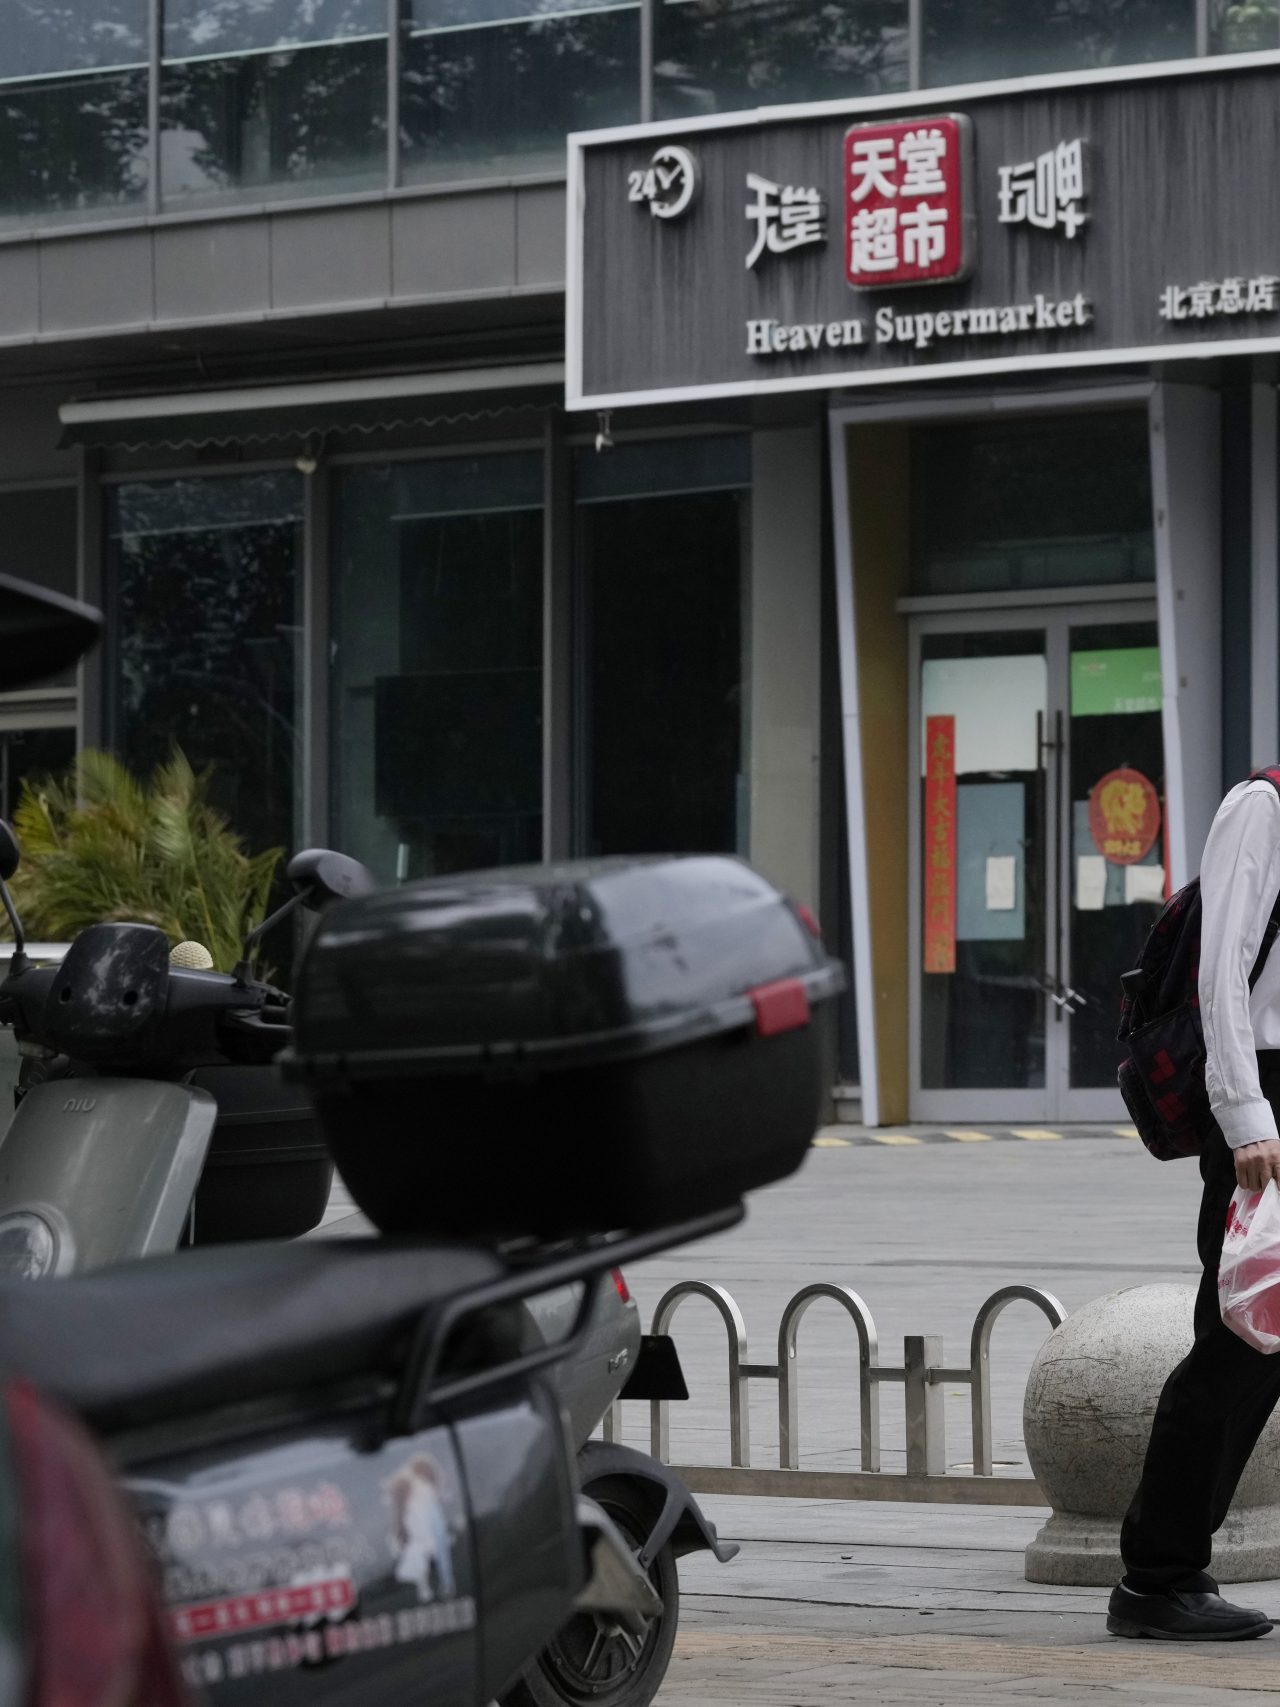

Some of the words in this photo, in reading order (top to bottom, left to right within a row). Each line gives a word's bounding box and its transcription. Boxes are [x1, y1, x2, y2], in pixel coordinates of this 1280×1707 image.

[850, 128, 948, 202] 天堂
[850, 201, 950, 276] 超市
[745, 317, 864, 355] Heaven
[874, 292, 1090, 349] Supermarket
[1158, 276, 1280, 320] 北京总店
